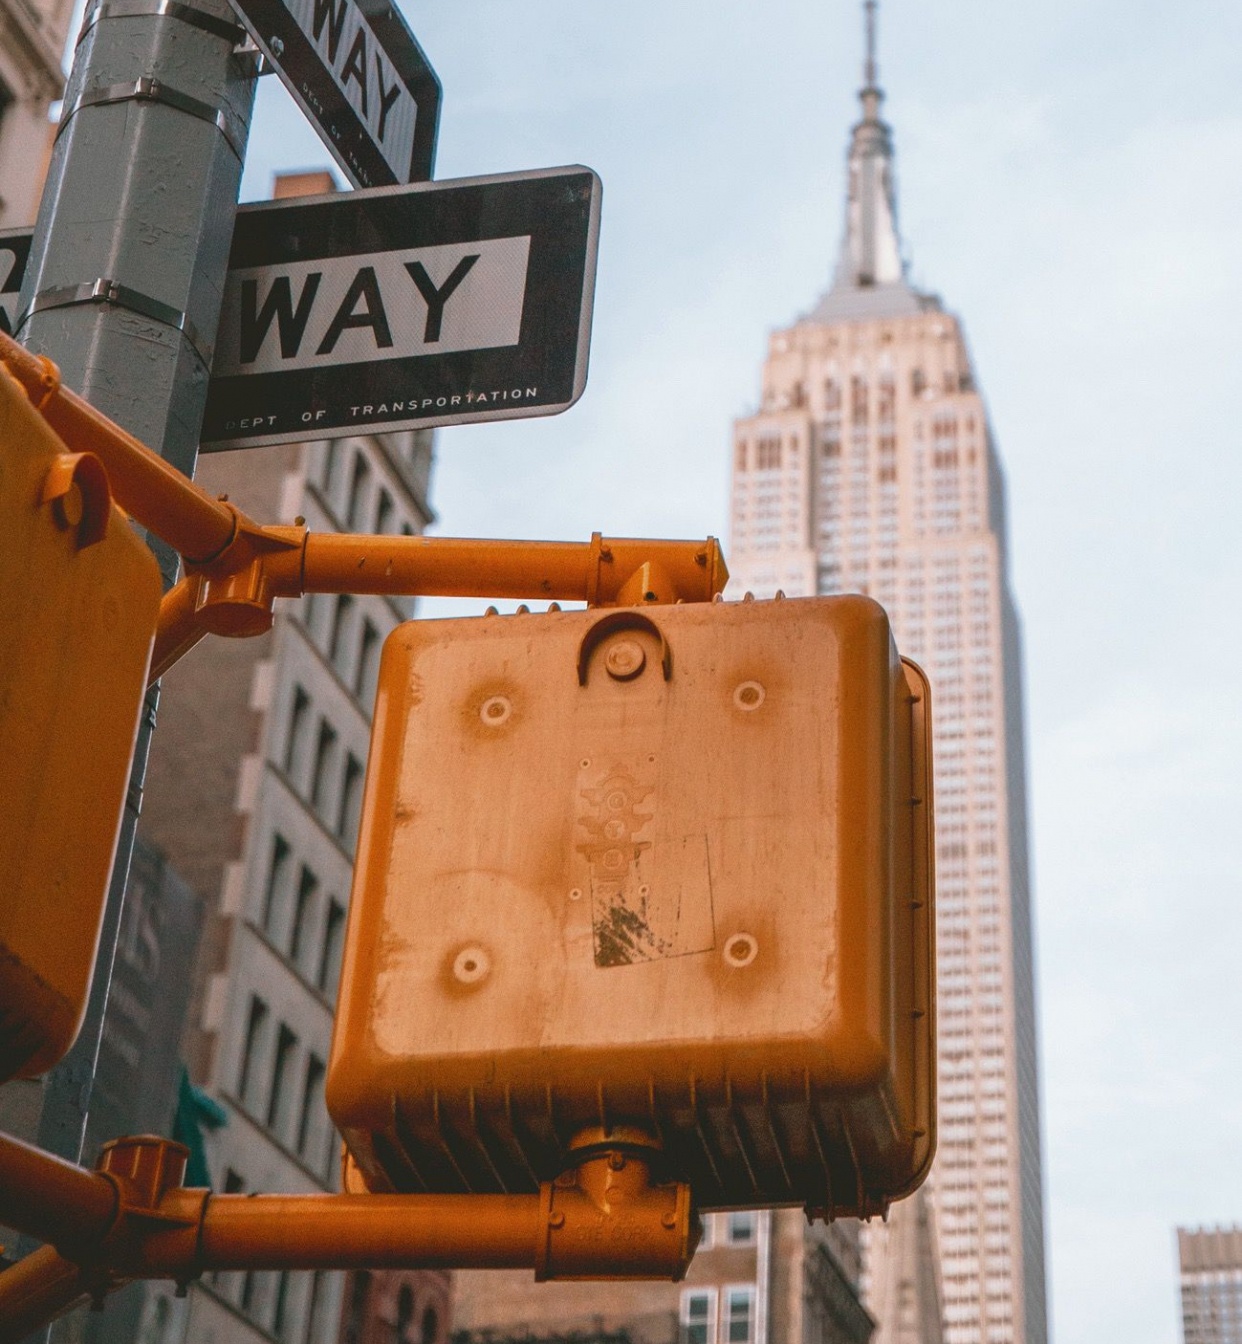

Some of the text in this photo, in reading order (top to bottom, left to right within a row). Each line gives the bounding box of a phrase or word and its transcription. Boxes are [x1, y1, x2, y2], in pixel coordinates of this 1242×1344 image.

[239, 254, 481, 365] WAY
[225, 387, 538, 430] DEPT OF TRANSPORTATION
